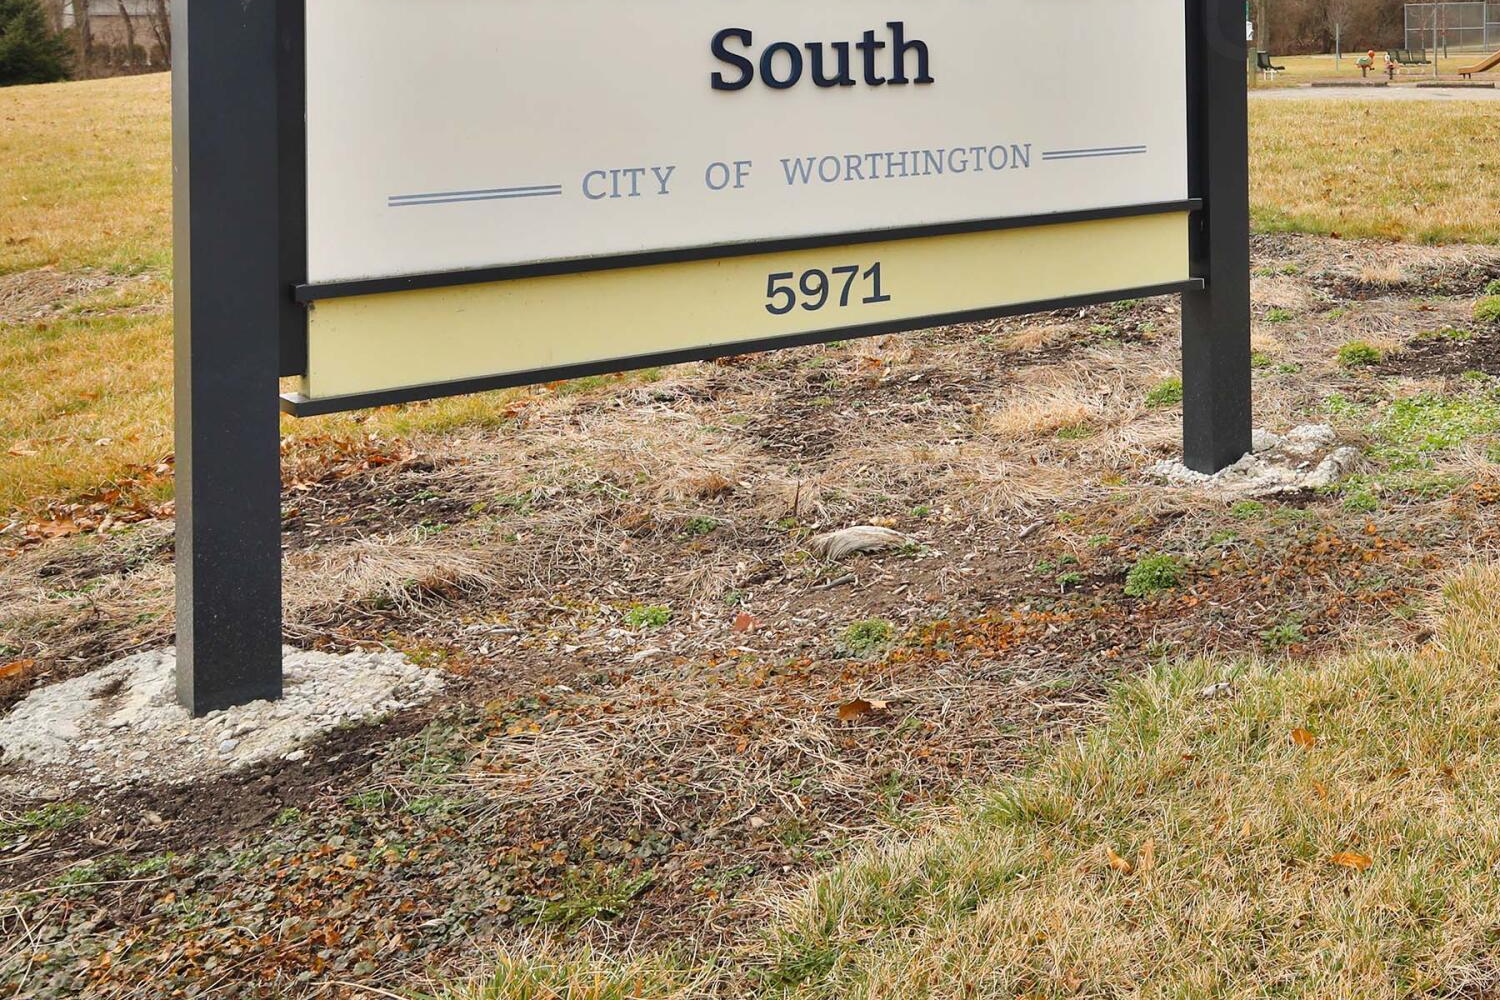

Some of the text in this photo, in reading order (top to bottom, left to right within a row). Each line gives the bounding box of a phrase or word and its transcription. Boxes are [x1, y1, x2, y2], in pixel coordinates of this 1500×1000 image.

[710, 21, 935, 91] South
[581, 143, 1033, 200] CITY OF WORTHINGTON
[764, 261, 891, 316] 5971
